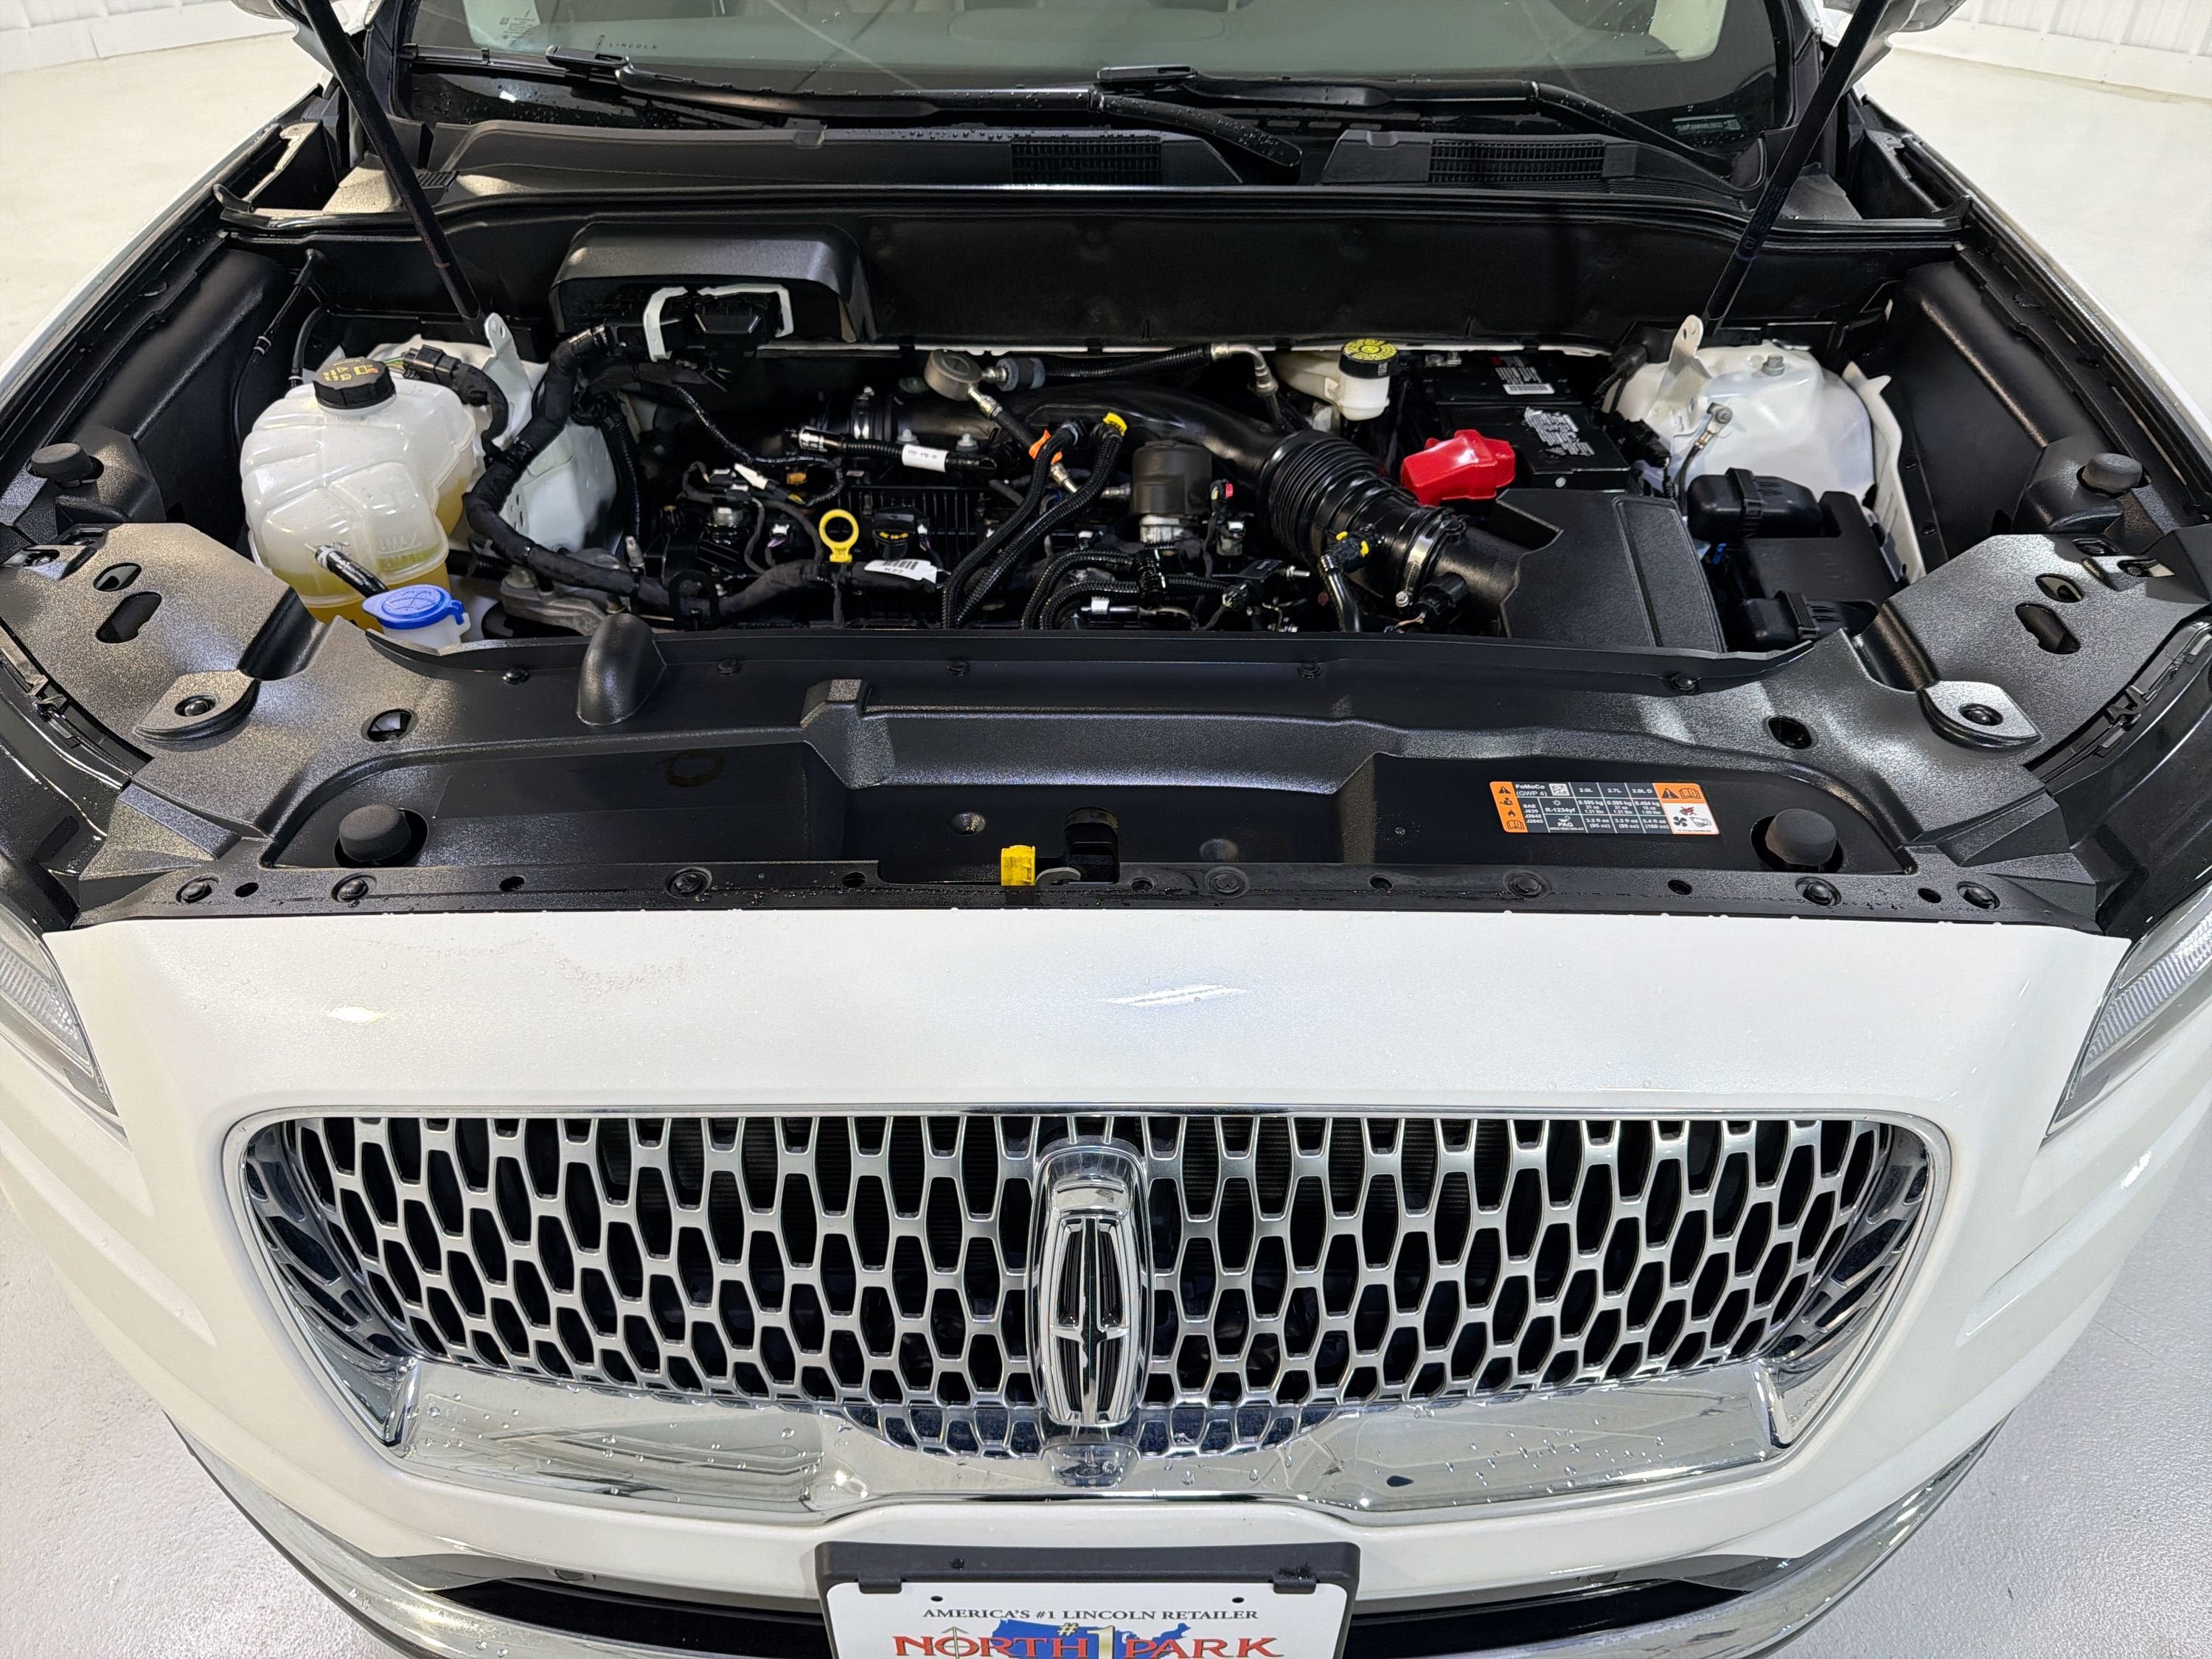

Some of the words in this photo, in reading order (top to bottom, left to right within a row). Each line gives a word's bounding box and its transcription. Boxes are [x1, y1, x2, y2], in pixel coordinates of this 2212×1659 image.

[922, 1609, 1030, 1619] AMERICA'S
[1035, 1610, 1057, 1619] #1
[1062, 1610, 1157, 1620] LINCOLN
[1162, 1610, 1259, 1619] RETAILER
[892, 1635, 1089, 1658] NORTH
[1124, 1637, 1285, 1658] PARK
